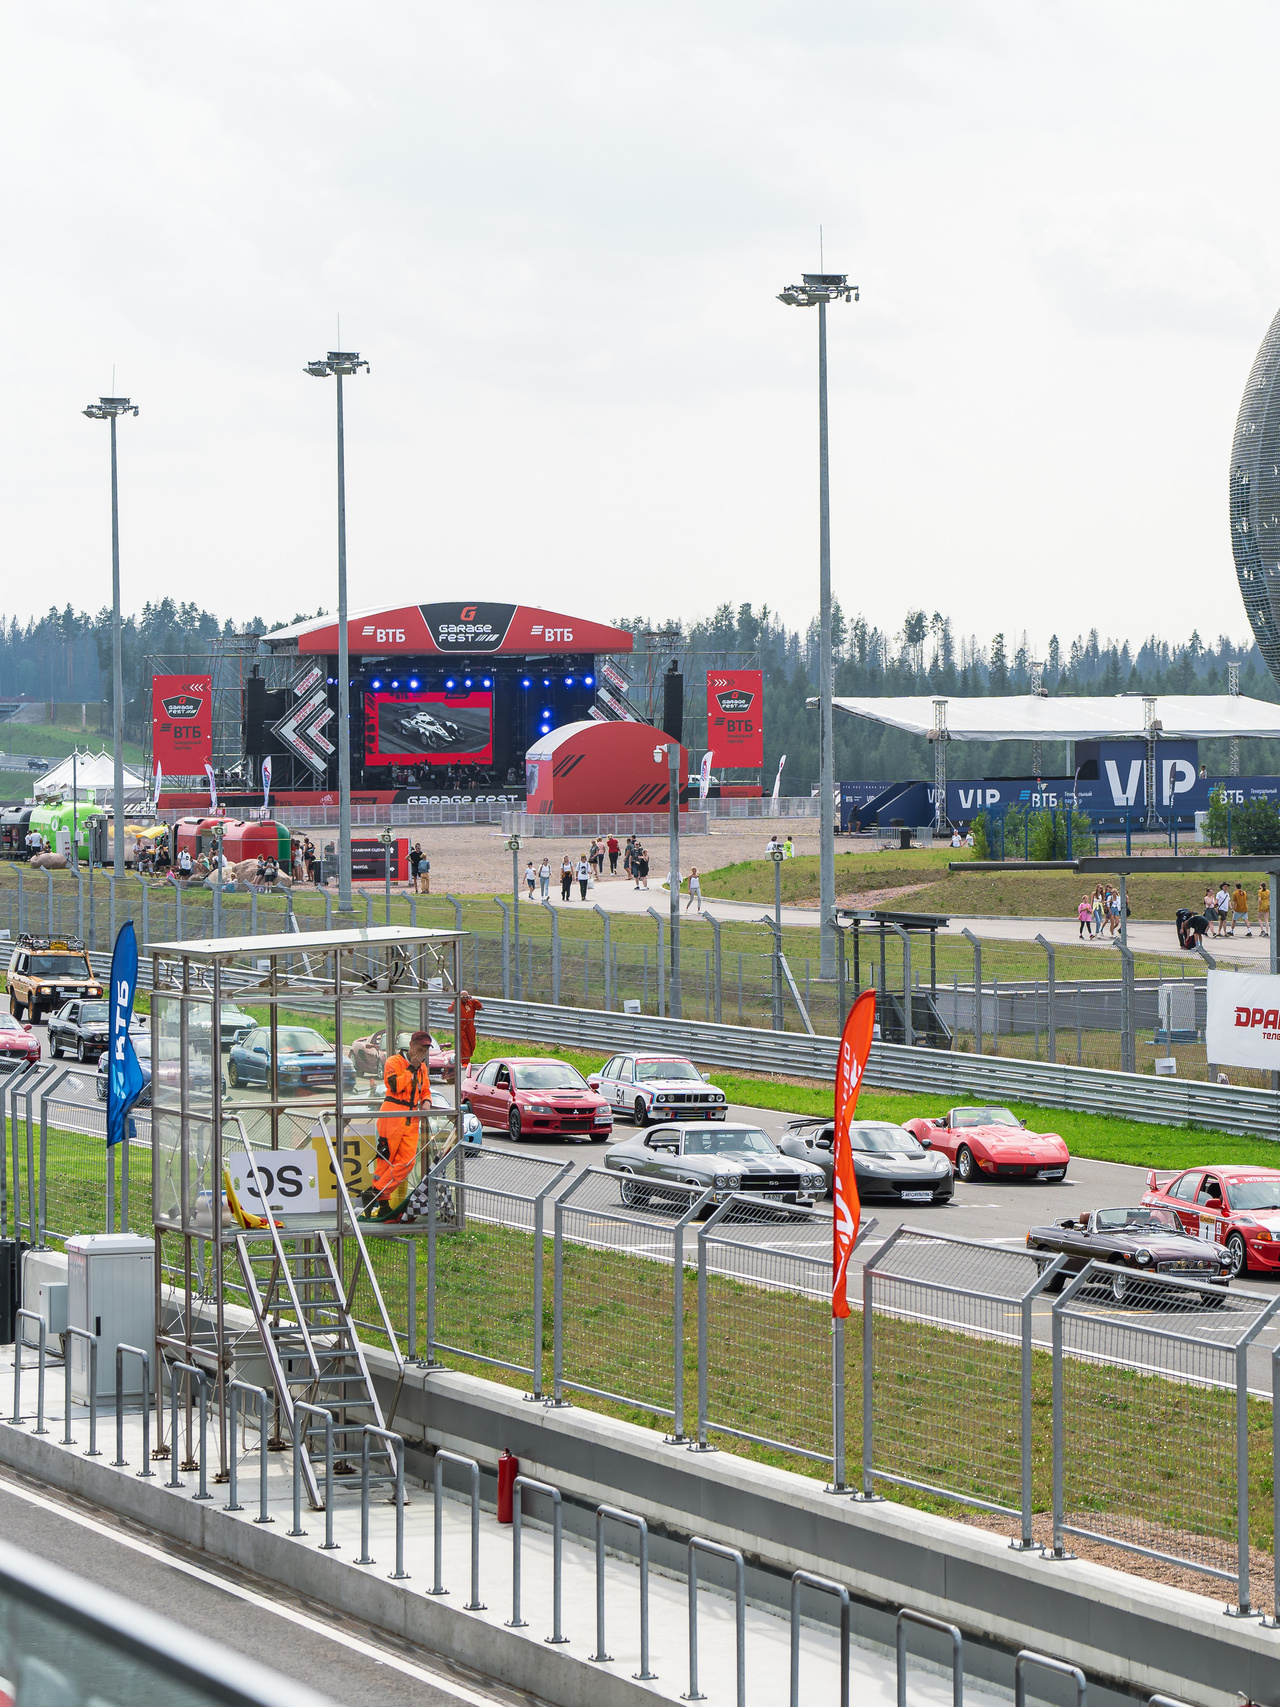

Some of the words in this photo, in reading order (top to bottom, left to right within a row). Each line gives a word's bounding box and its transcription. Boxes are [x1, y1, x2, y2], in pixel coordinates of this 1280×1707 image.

[376, 629, 406, 643] ВТБ
[544, 627, 574, 642] ВТБ
[173, 726, 201, 739] ВТБ
[727, 720, 753, 732] ВТБ
[1104, 759, 1197, 806] VIP
[958, 789, 1001, 809] VIP
[1031, 793, 1058, 807] ВТБ
[1219, 789, 1245, 804] ВТБ
[115, 980, 129, 1060] ВТБ
[616, 1089, 625, 1106] 54
